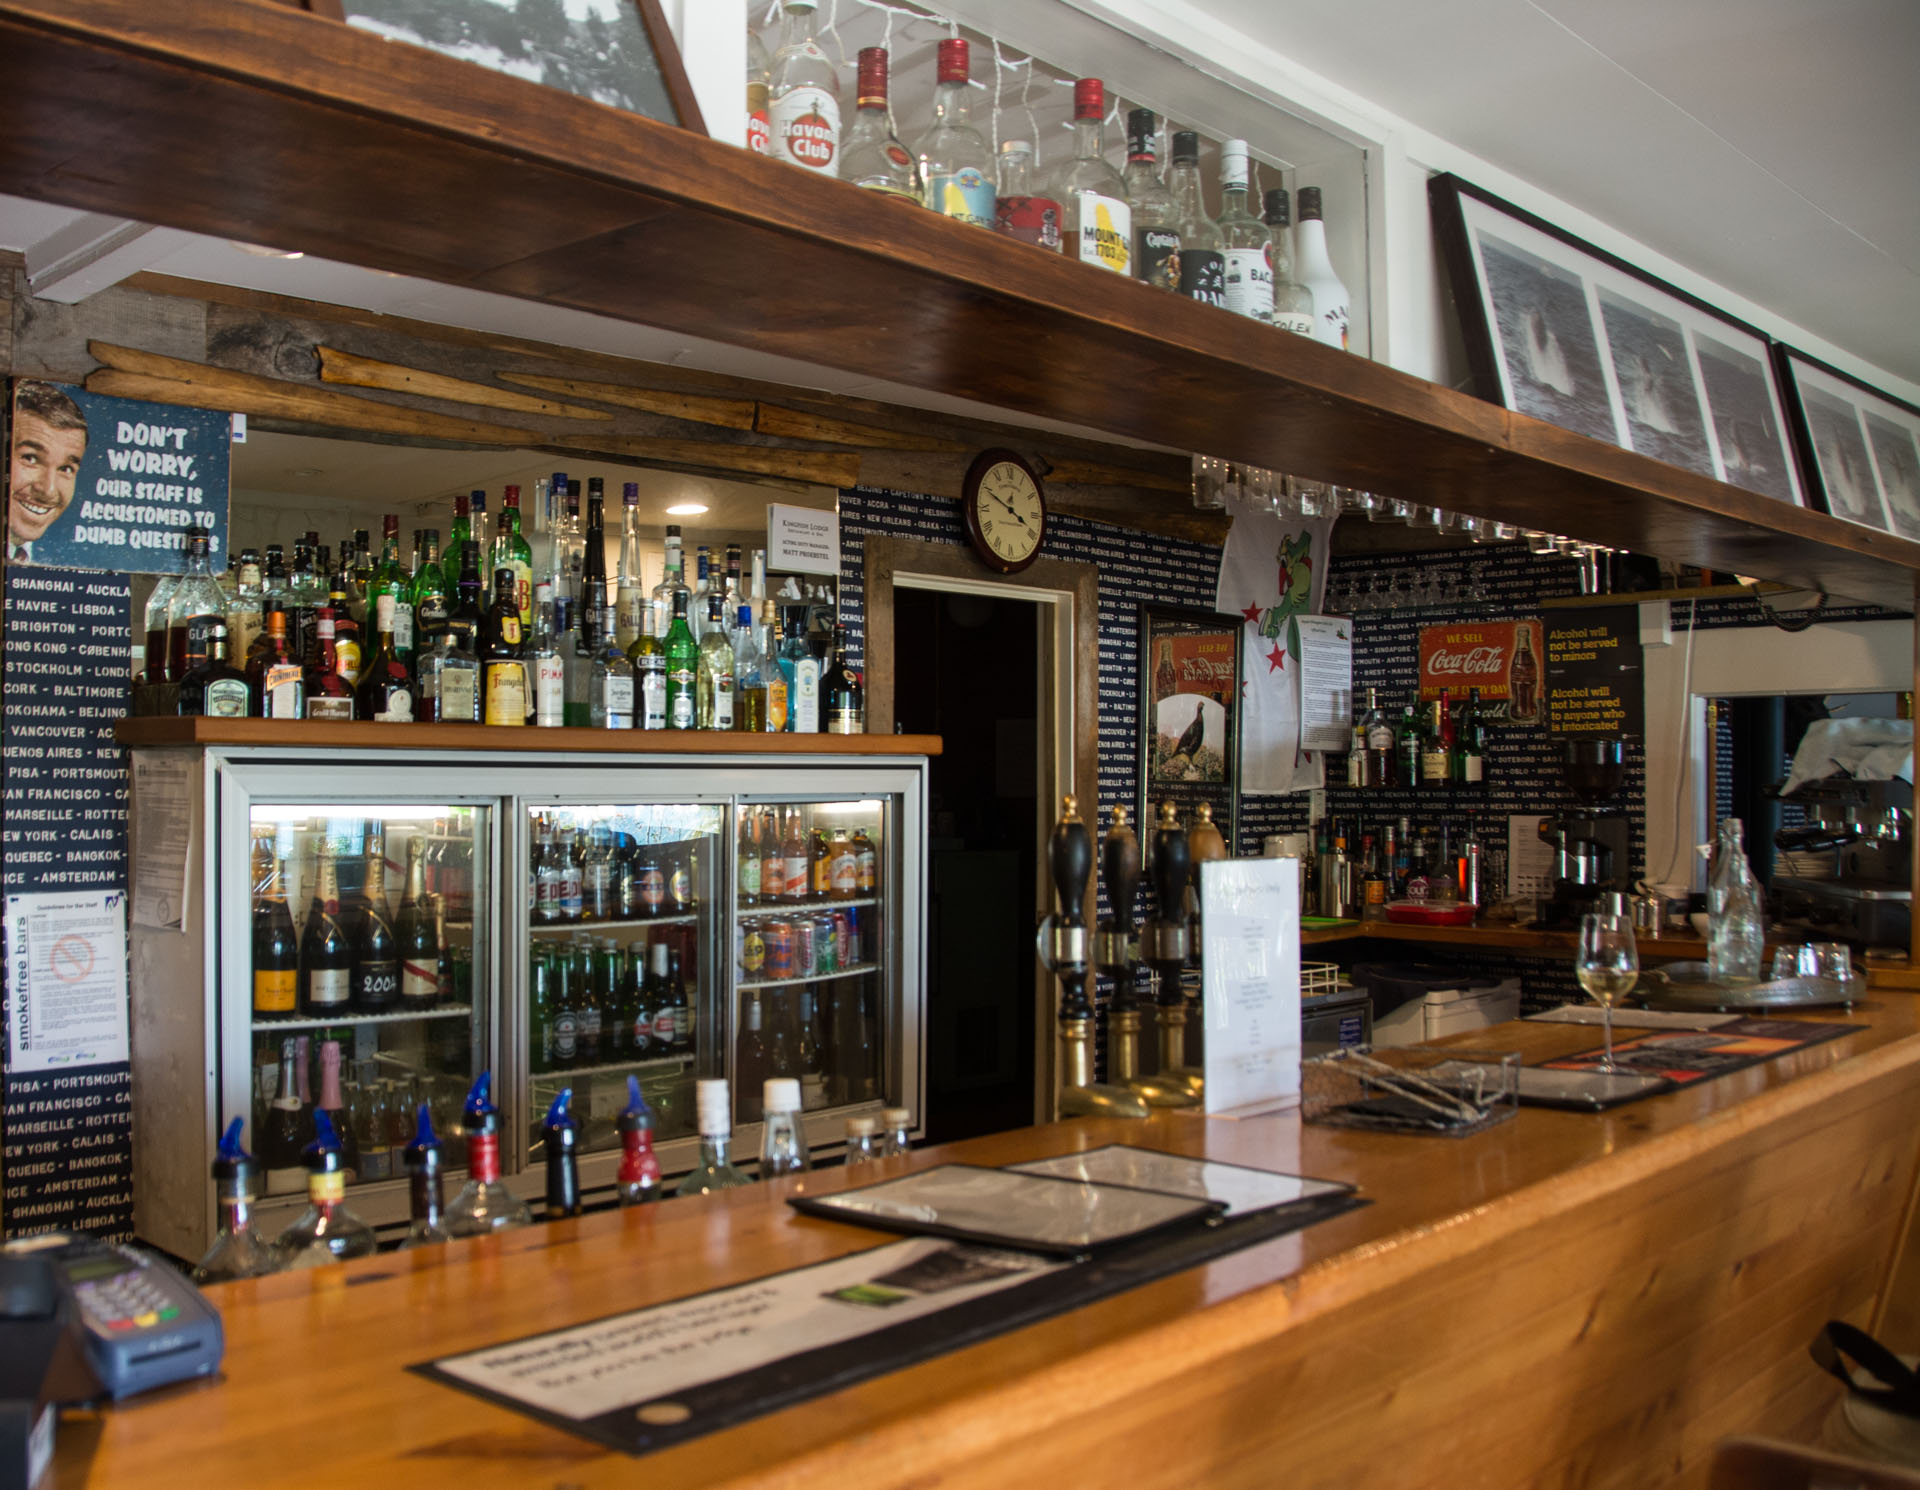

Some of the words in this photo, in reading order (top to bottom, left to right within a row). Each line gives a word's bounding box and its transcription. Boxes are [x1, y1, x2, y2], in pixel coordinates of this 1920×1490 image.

[793, 139, 829, 159] Club
[117, 422, 188, 449] DON'T
[108, 450, 198, 480] WORRY,
[96, 478, 132, 499] OUR
[136, 482, 184, 502] STAFF
[187, 486, 202, 504] IS
[80, 500, 190, 526] ACCUSTOMED
[194, 511, 214, 529] TO
[75, 525, 126, 546] DUMB
[129, 528, 219, 552] QUESTIS
[12, 578, 74, 592] SHANGHAI
[16, 600, 58, 612] HAVRE
[72, 604, 115, 616] LISBOA
[12, 620, 76, 634] BRIGHTON
[1550, 628, 1588, 640] Alcohol
[1590, 626, 1608, 636] will
[1446, 634, 1462, 644] WE
[1464, 634, 1484, 643] SELL
[1550, 642, 1566, 652] not
[1568, 640, 1581, 650] be
[1583, 638, 1618, 649] served
[4, 641, 31, 650] ONG
[34, 642, 67, 654] KONG
[1428, 646, 1504, 675] Coca-Cola
[1550, 652, 1560, 662] to
[1562, 652, 1596, 661] minors
[6, 662, 82, 676] STOCKHOLM
[4, 683, 36, 694] CORK
[54, 685, 124, 698] BALTIMORE
[1424, 687, 1442, 696] PAR
[1462, 686, 1488, 694] EVRY
[1490, 685, 1509, 694] DAY
[1552, 688, 1588, 698] Alcohol
[1591, 686, 1610, 696] will
[1551, 700, 1568, 710] not
[1570, 699, 1582, 708] be
[1584, 697, 1620, 708] served
[3, 705, 66, 717] OKOHAMA
[79, 706, 126, 718] BEIJING
[1551, 711, 1562, 720] to
[1564, 711, 1600, 722] anyone
[1602, 708, 1626, 718] who
[11, 726, 85, 738] VANCOUVER
[1552, 722, 1560, 732] is
[1562, 720, 1618, 731] intoxicated
[2, 747, 44, 758] UENOS
[46, 748, 82, 758] AIRES
[97, 750, 120, 758] NEW
[9, 767, 38, 778] PISA
[28, 788, 100, 800] FRANCISCO
[5, 809, 73, 820] MARSEILLE
[84, 809, 129, 820] ROTTE
[2, 830, 20, 842] EW
[24, 830, 58, 841] YORK
[70, 829, 113, 840] CALAIS
[4, 852, 52, 864] QUEBEC
[66, 850, 120, 862] BANGKOK
[4, 873, 26, 884] ICE
[40, 871, 116, 884] AMSTERDAM
[16, 916, 27, 955] bars
[16, 960, 29, 1050] smokefree
[10, 1080, 40, 1094] PISA
[30, 1096, 100, 1113] FRANCISCO
[8, 1118, 74, 1136] MARSEILLE
[5, 1146, 22, 1158] EW
[28, 1141, 59, 1155] YORK
[72, 1134, 114, 1148] CALAIS
[8, 1162, 56, 1178] QUEBEC
[70, 1154, 122, 1171] BANGKOK
[6, 1186, 28, 1199] ICE
[44, 1174, 117, 1194] AMSTERDAM
[12, 1200, 74, 1218] SHANGHAI
[18, 1224, 58, 1237] HAVRE
[72, 1214, 115, 1231] LISBOA
